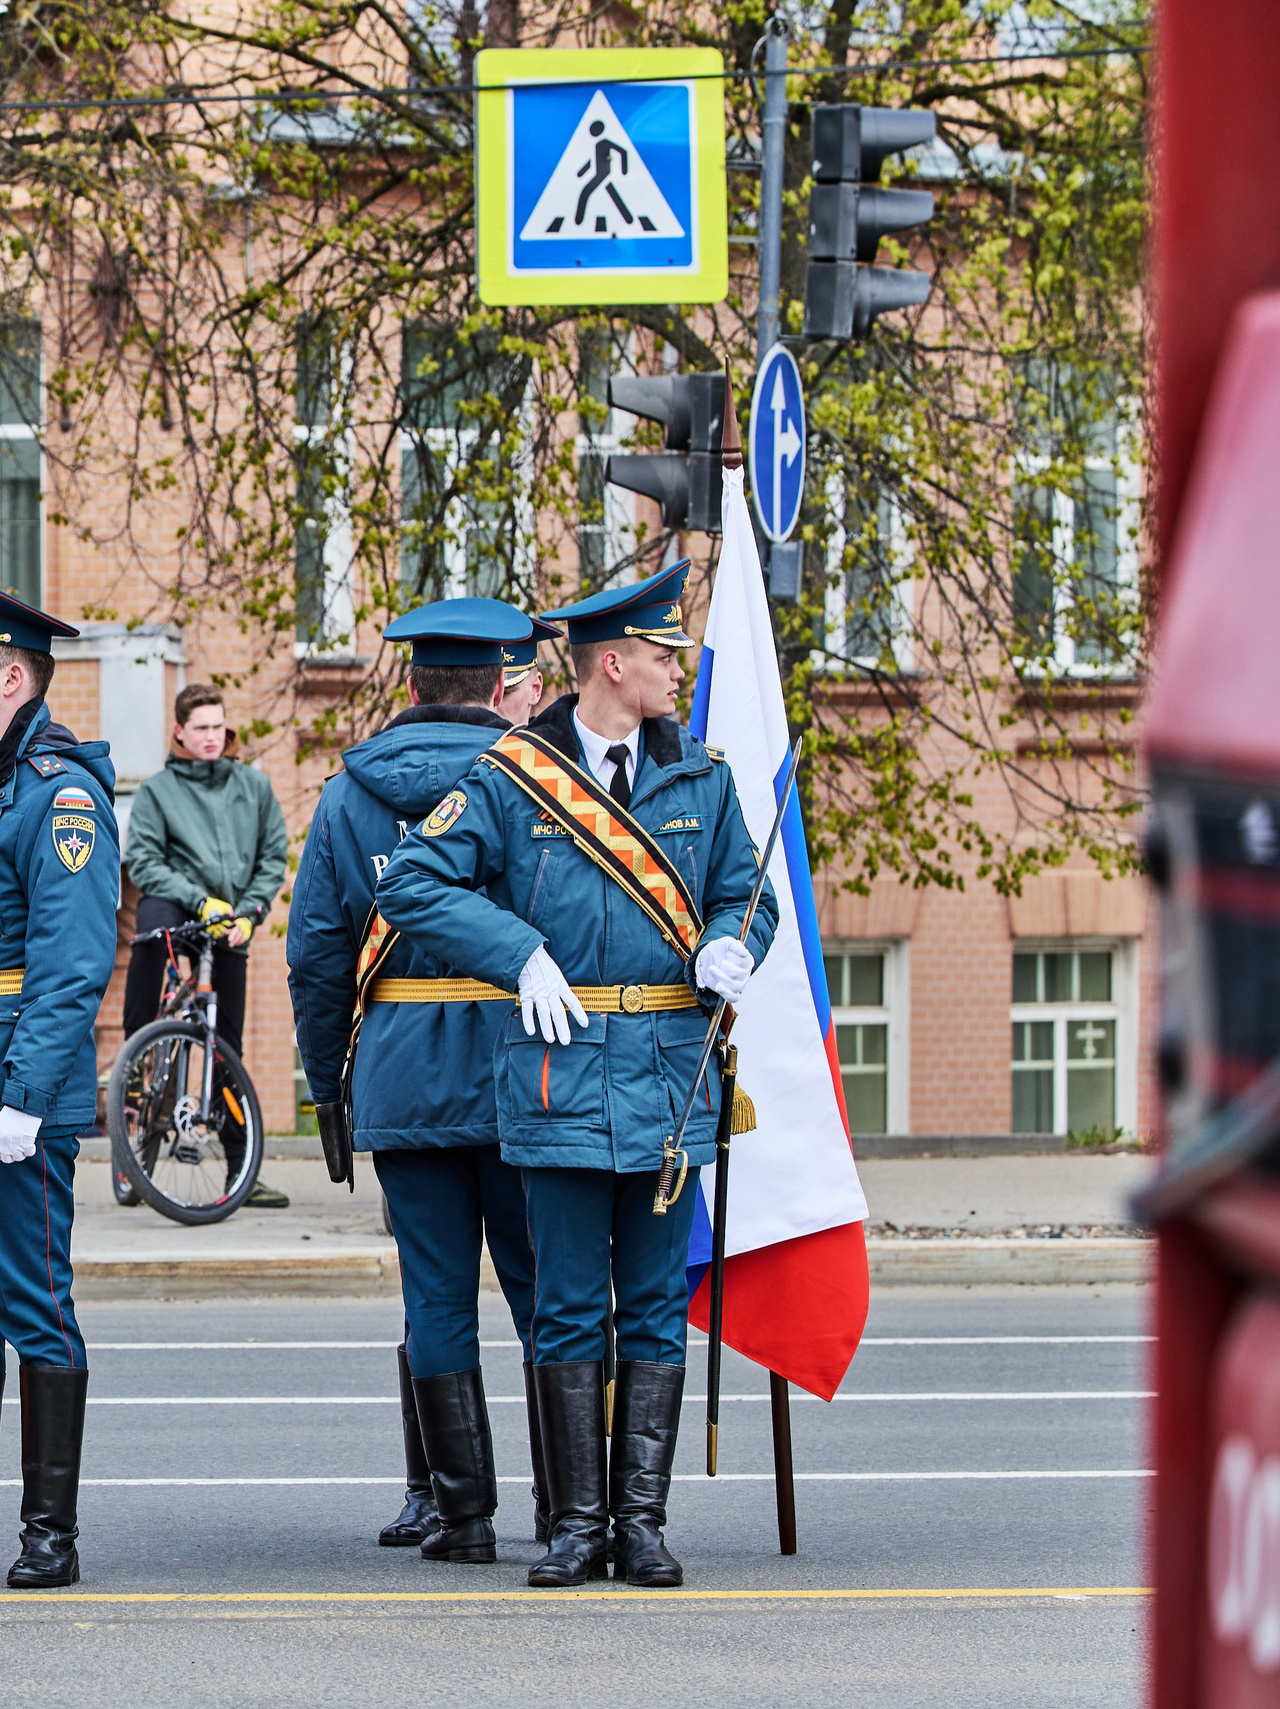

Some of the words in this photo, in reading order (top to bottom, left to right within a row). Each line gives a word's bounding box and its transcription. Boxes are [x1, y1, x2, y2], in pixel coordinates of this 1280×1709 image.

[56, 818, 69, 827] МЧС
[70, 817, 93, 830] РОССИИ
[533, 825, 552, 835] МЧС
